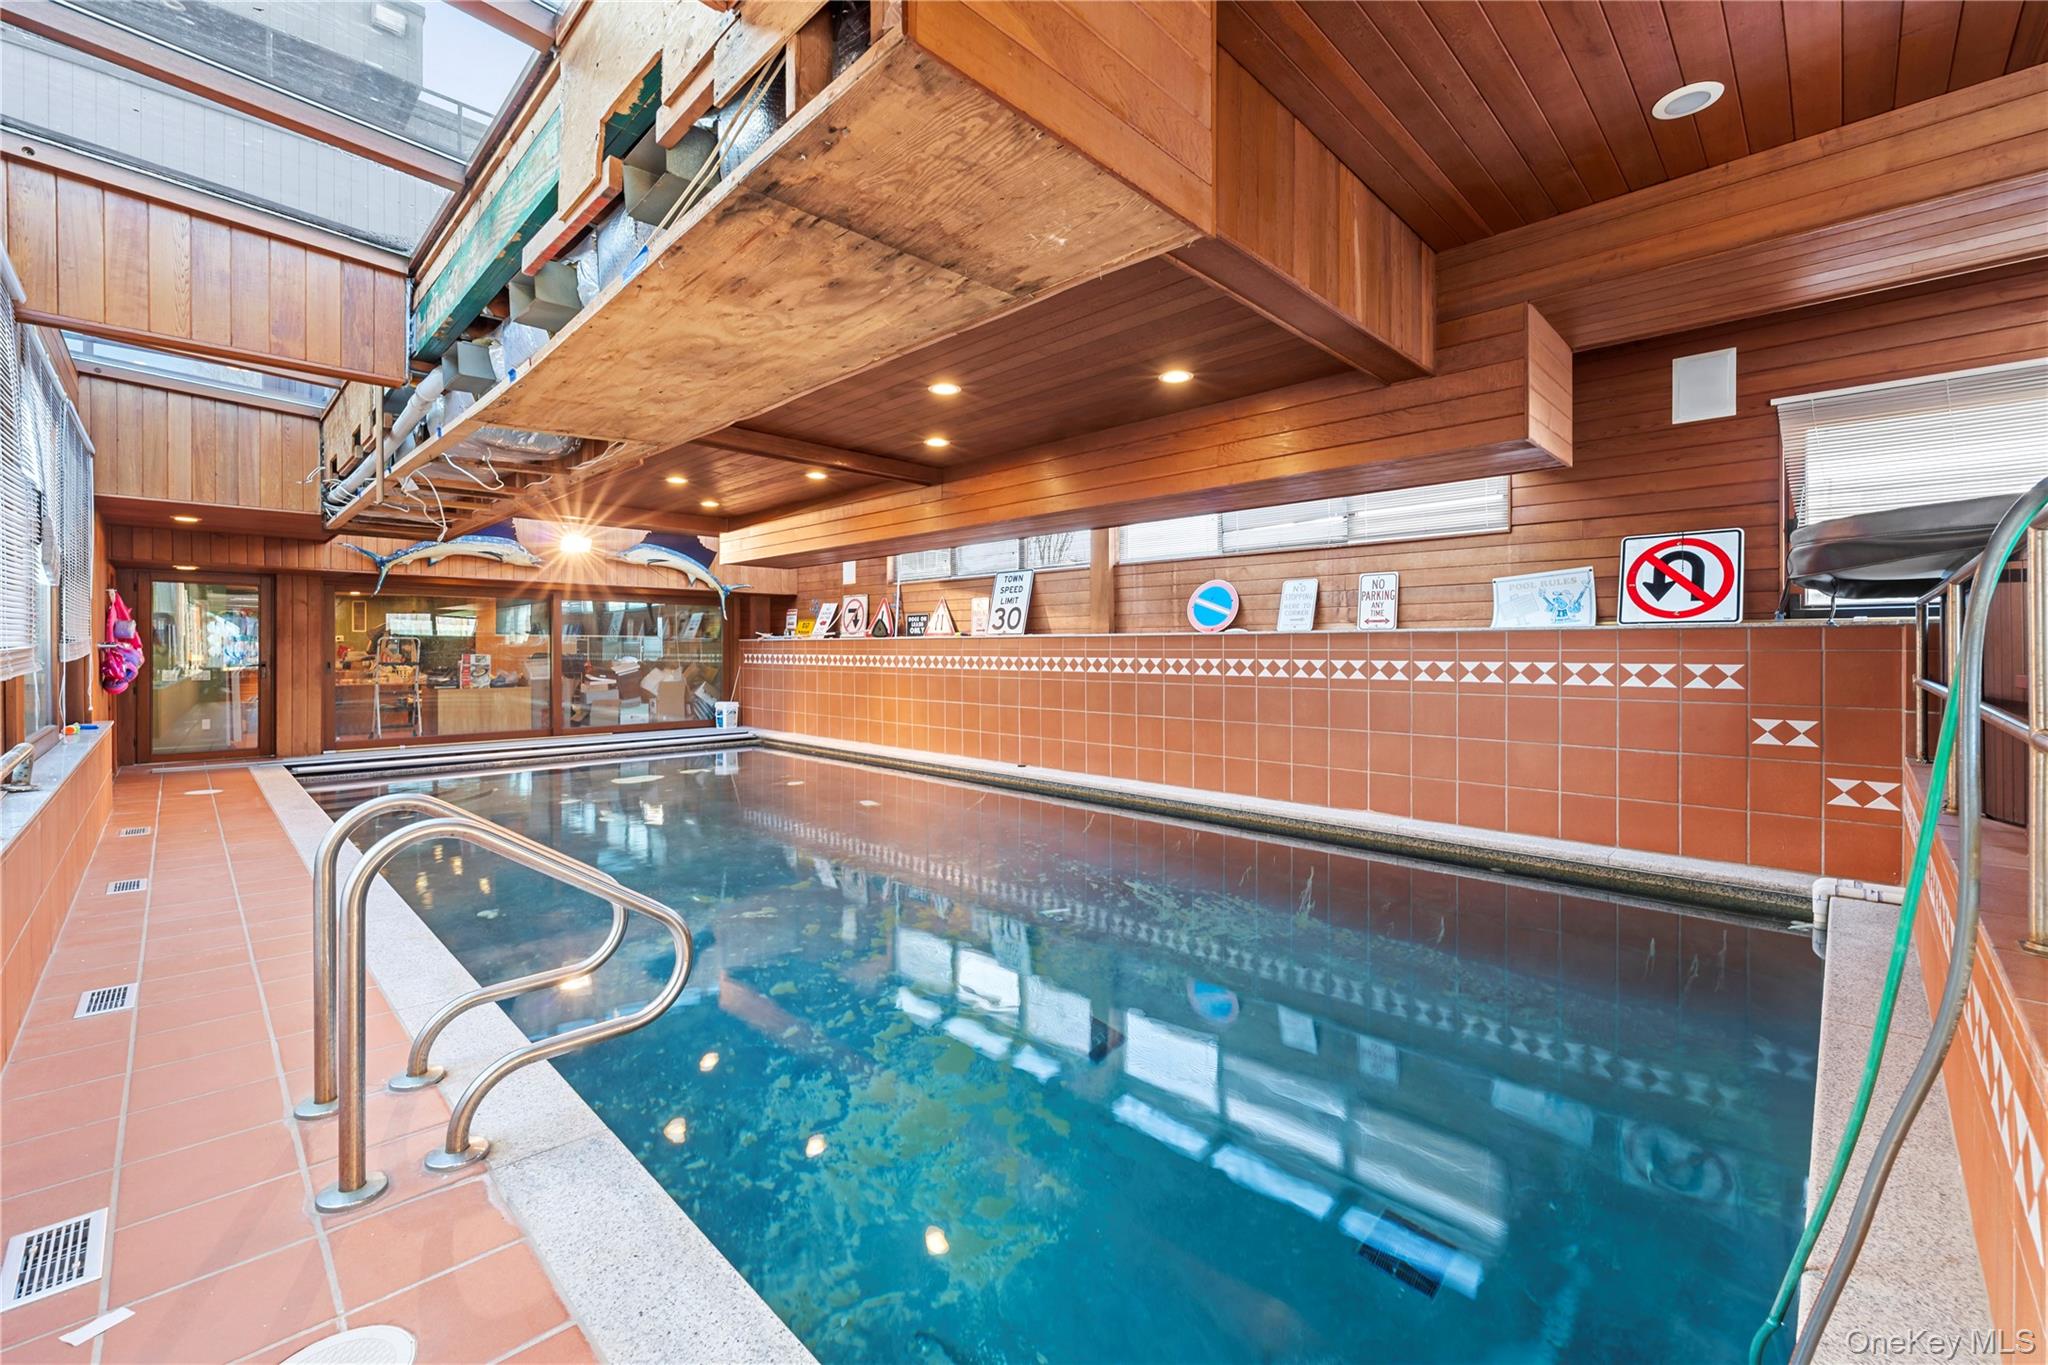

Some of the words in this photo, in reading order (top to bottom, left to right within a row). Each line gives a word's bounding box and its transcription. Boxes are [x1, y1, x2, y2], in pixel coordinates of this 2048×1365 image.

[1004, 574, 1024, 583] TOWN
[1372, 579, 1386, 589] NO
[1509, 582, 1537, 591] POOL
[1540, 576, 1577, 588] RULES
[1000, 585, 1024, 594] SPEED
[1361, 590, 1395, 601] PARKING
[1000, 597, 1019, 605] LIMIT
[1370, 609, 1385, 617] TIME
[992, 607, 1022, 630] 30
